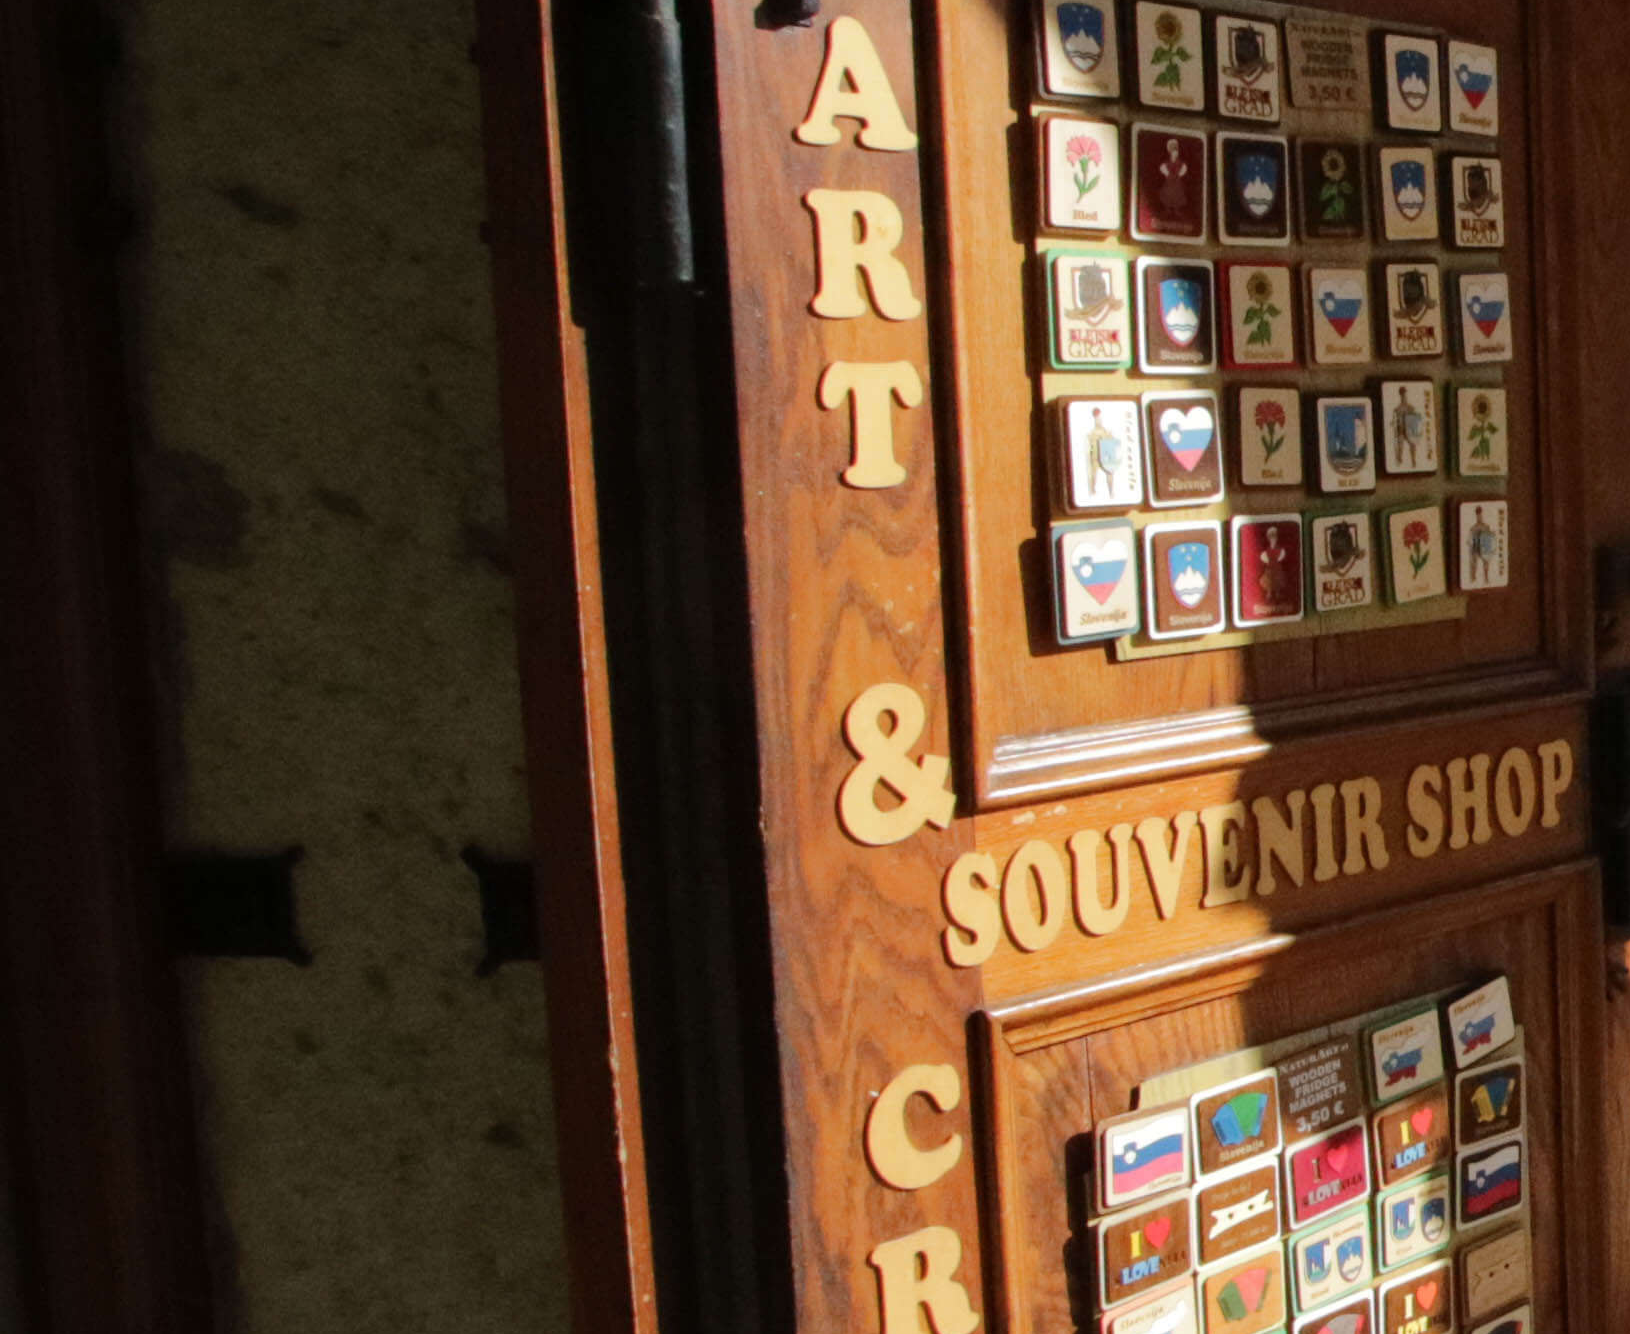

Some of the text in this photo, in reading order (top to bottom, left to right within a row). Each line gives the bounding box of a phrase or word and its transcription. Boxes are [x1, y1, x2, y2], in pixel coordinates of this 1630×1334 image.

[1301, 40, 1353, 54] WOODEN
[1308, 84, 1341, 103] 3,50
[1224, 100, 1273, 116] GRAD
[796, 15, 924, 490] ART
[1068, 342, 1122, 359] GRAD
[1167, 478, 1213, 492] Slovenija
[1079, 610, 1127, 626] Slovenija
[838, 682, 957, 846] &
[942, 739, 1574, 967] SOUVENIR SHOP
[1289, 1059, 1342, 1087] WOODEN
[1294, 1072, 1338, 1099] FRIDGE
[1289, 1083, 1347, 1114] MAGNETS
[1296, 1100, 1345, 1133] 3,50 €
[1220, 1139, 1265, 1162] Slovenija
[1130, 1230, 1142, 1259] I
